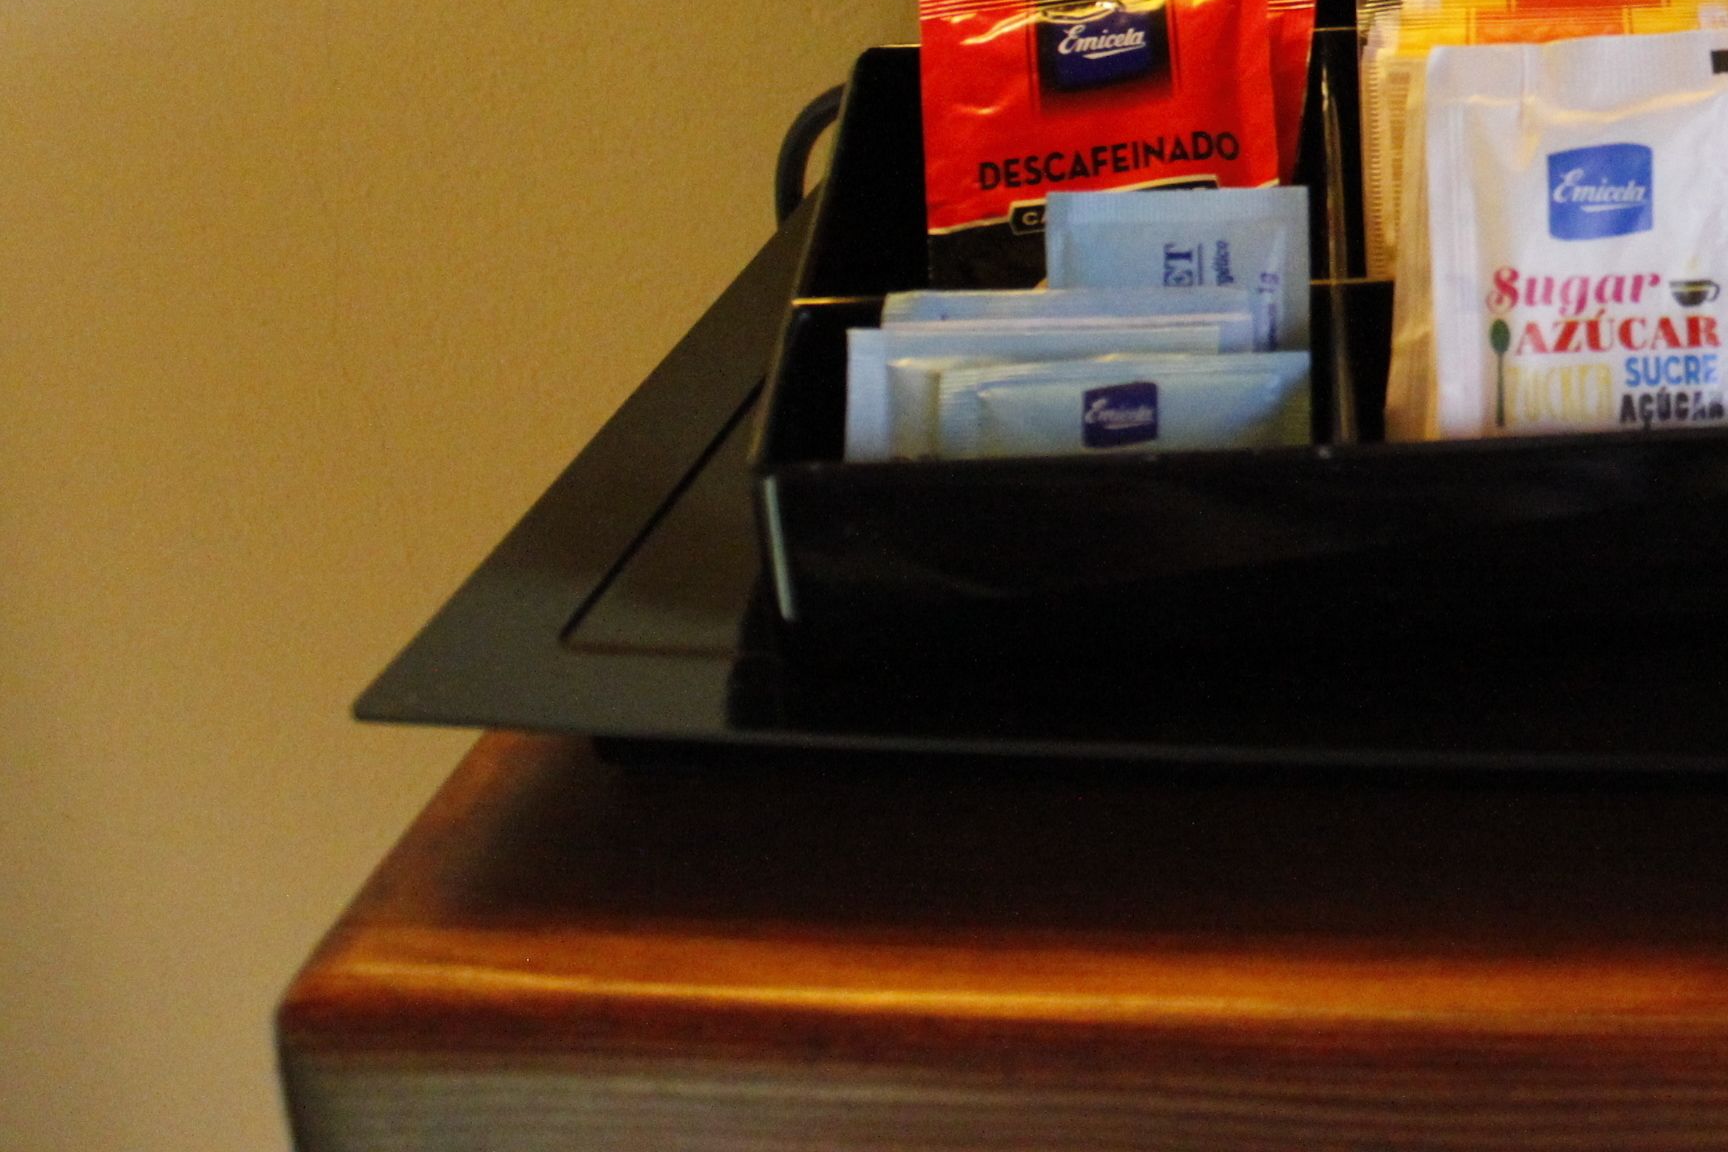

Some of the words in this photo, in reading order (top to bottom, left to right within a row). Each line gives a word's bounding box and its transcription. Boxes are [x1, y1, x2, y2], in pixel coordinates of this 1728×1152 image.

[977, 130, 1240, 191] DESCAFEINADO
[1486, 266, 1661, 315] Sugar
[1515, 308, 1721, 356] AZÚCAR
[1624, 354, 1718, 388] SUCRE
